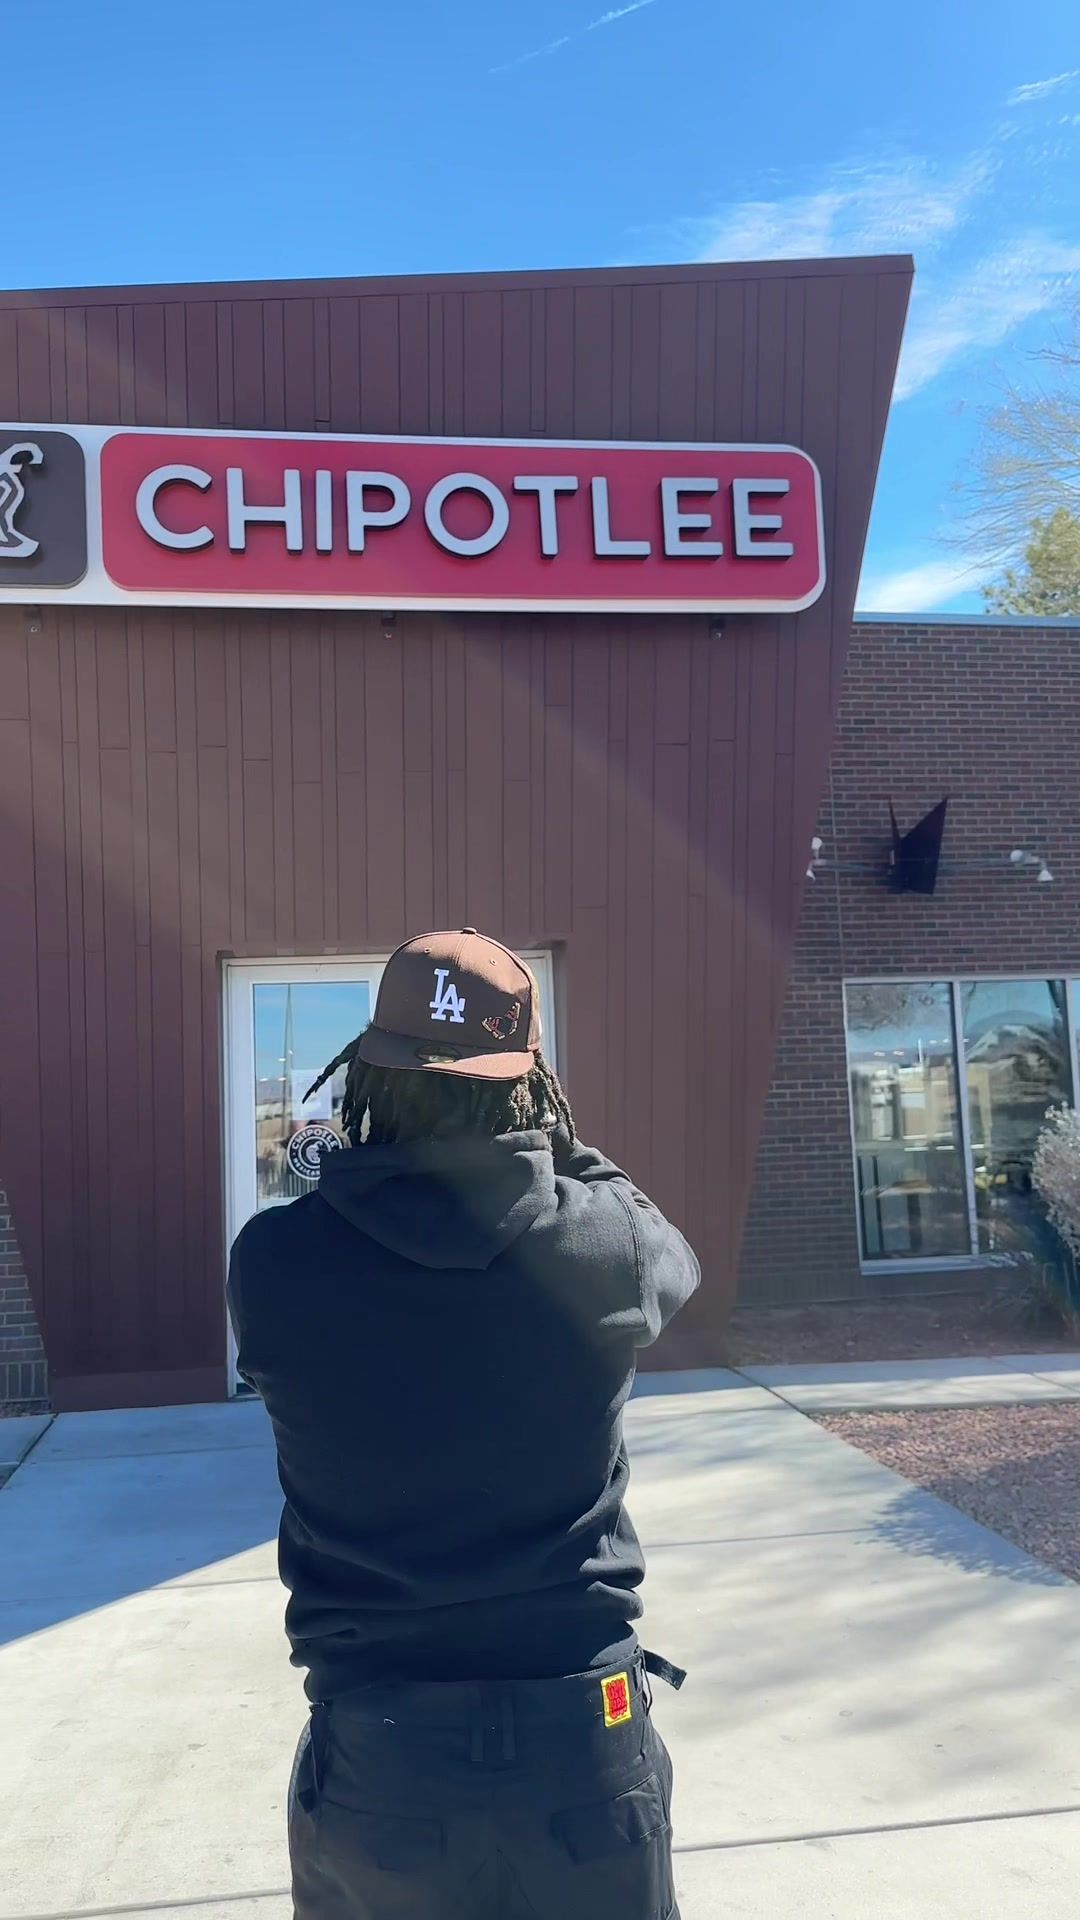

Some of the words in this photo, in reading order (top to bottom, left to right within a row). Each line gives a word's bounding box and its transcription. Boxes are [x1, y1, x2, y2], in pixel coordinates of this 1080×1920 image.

[136, 464, 794, 558] CHIPOTLEE
[429, 968, 466, 1023] LA
[291, 1128, 338, 1149] CHIPOTLE
